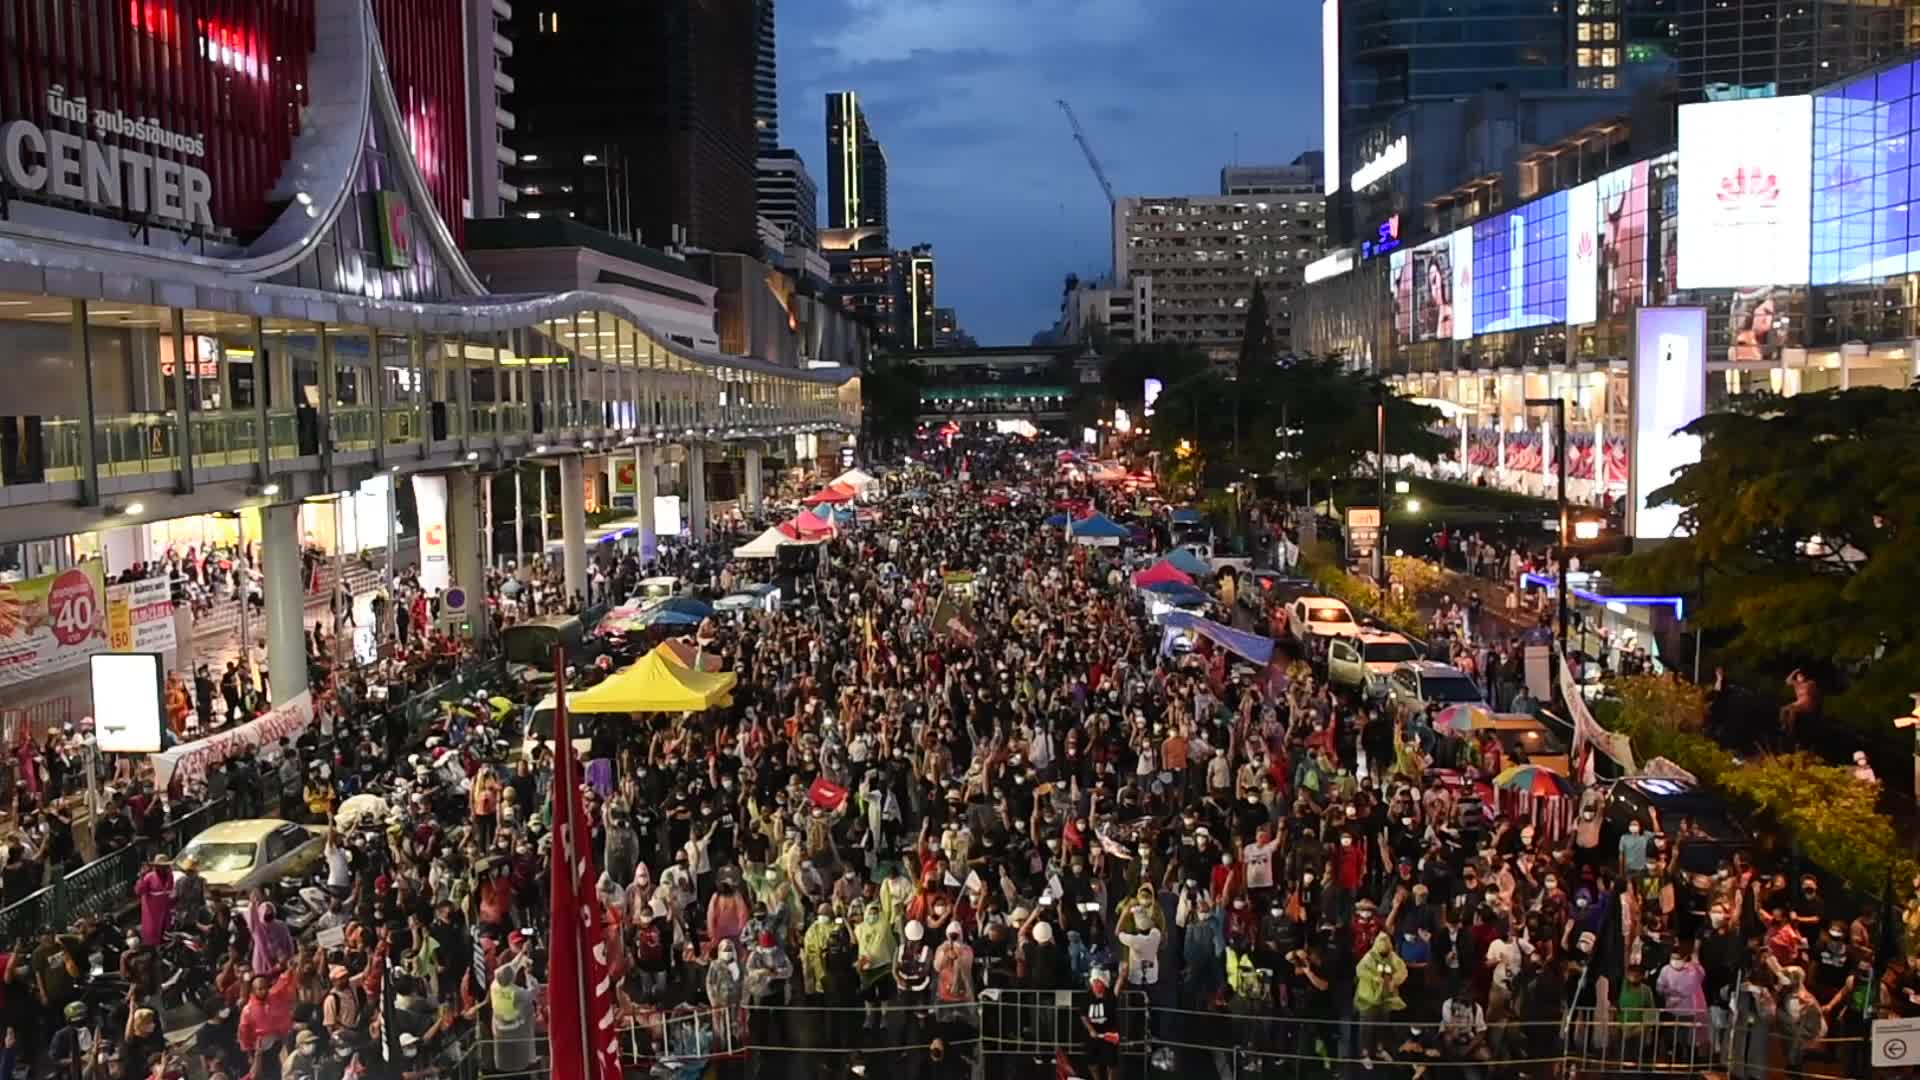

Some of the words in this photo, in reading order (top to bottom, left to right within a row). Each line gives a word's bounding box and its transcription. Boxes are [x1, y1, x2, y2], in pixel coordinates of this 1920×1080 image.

[3, 119, 214, 233] CENTER
[57, 595, 91, 632] 40
[110, 631, 129, 649] 150
